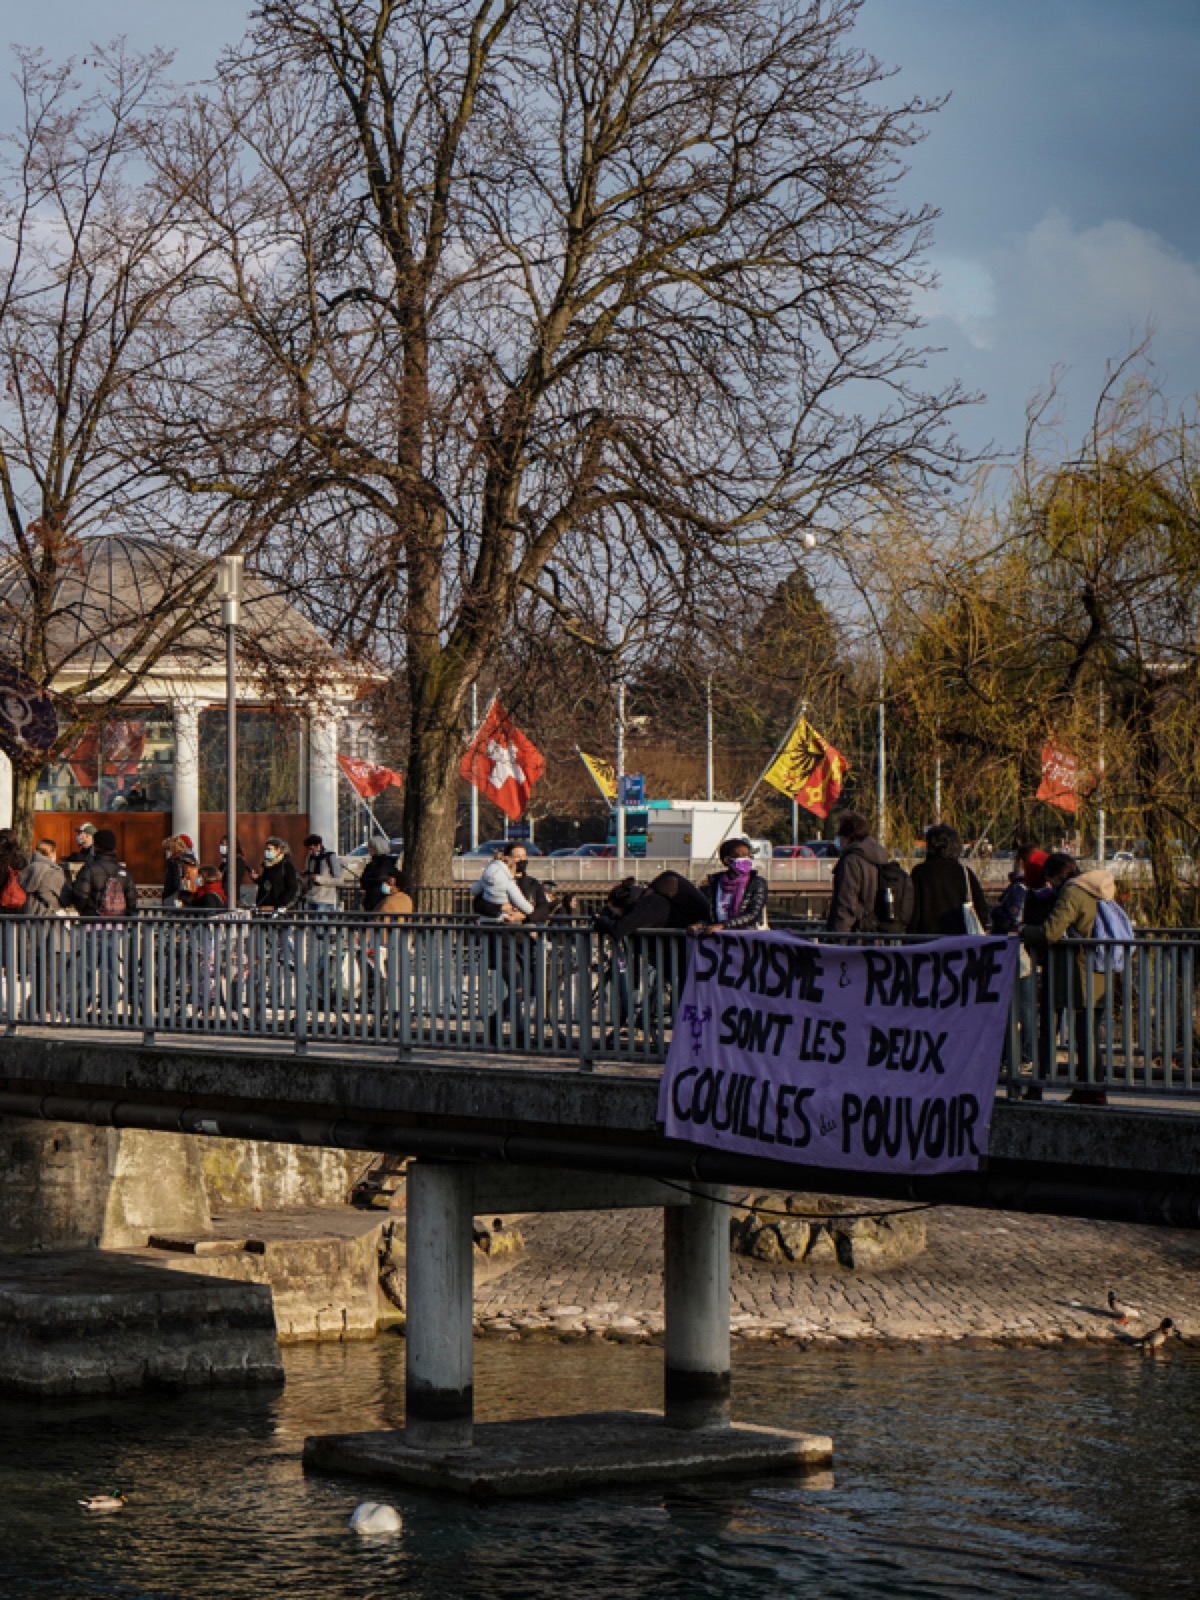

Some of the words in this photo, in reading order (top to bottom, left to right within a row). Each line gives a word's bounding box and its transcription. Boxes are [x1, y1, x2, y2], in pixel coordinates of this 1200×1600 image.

[695, 936, 825, 1003] SEXISME
[862, 941, 1009, 1009] RACISME
[719, 1005, 793, 1057] SONT
[800, 1017, 847, 1064] LES
[867, 1025, 947, 1074] DEUX
[671, 1066, 816, 1148] COUILLES
[841, 1093, 980, 1161] POUVOIR
